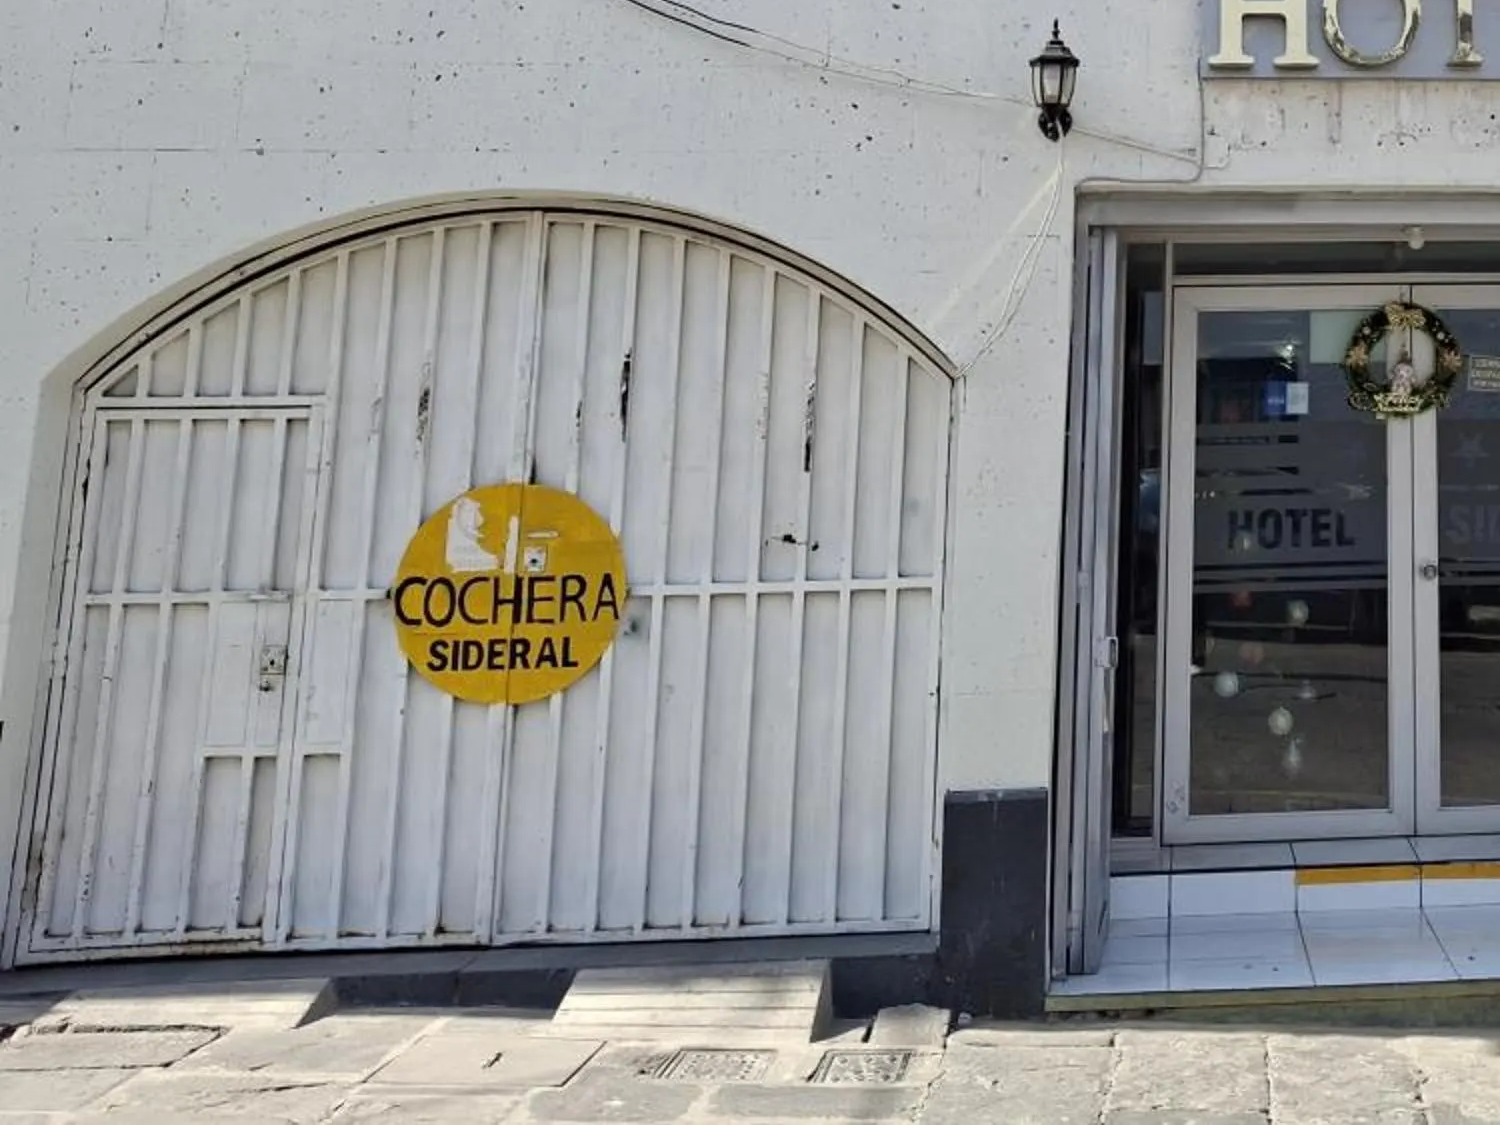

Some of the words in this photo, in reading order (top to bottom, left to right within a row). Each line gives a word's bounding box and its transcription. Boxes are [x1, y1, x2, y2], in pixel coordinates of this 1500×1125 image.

[1226, 507, 1356, 550] HOTEL
[394, 573, 620, 627] COCHERA
[427, 636, 579, 672] SIDERAL
